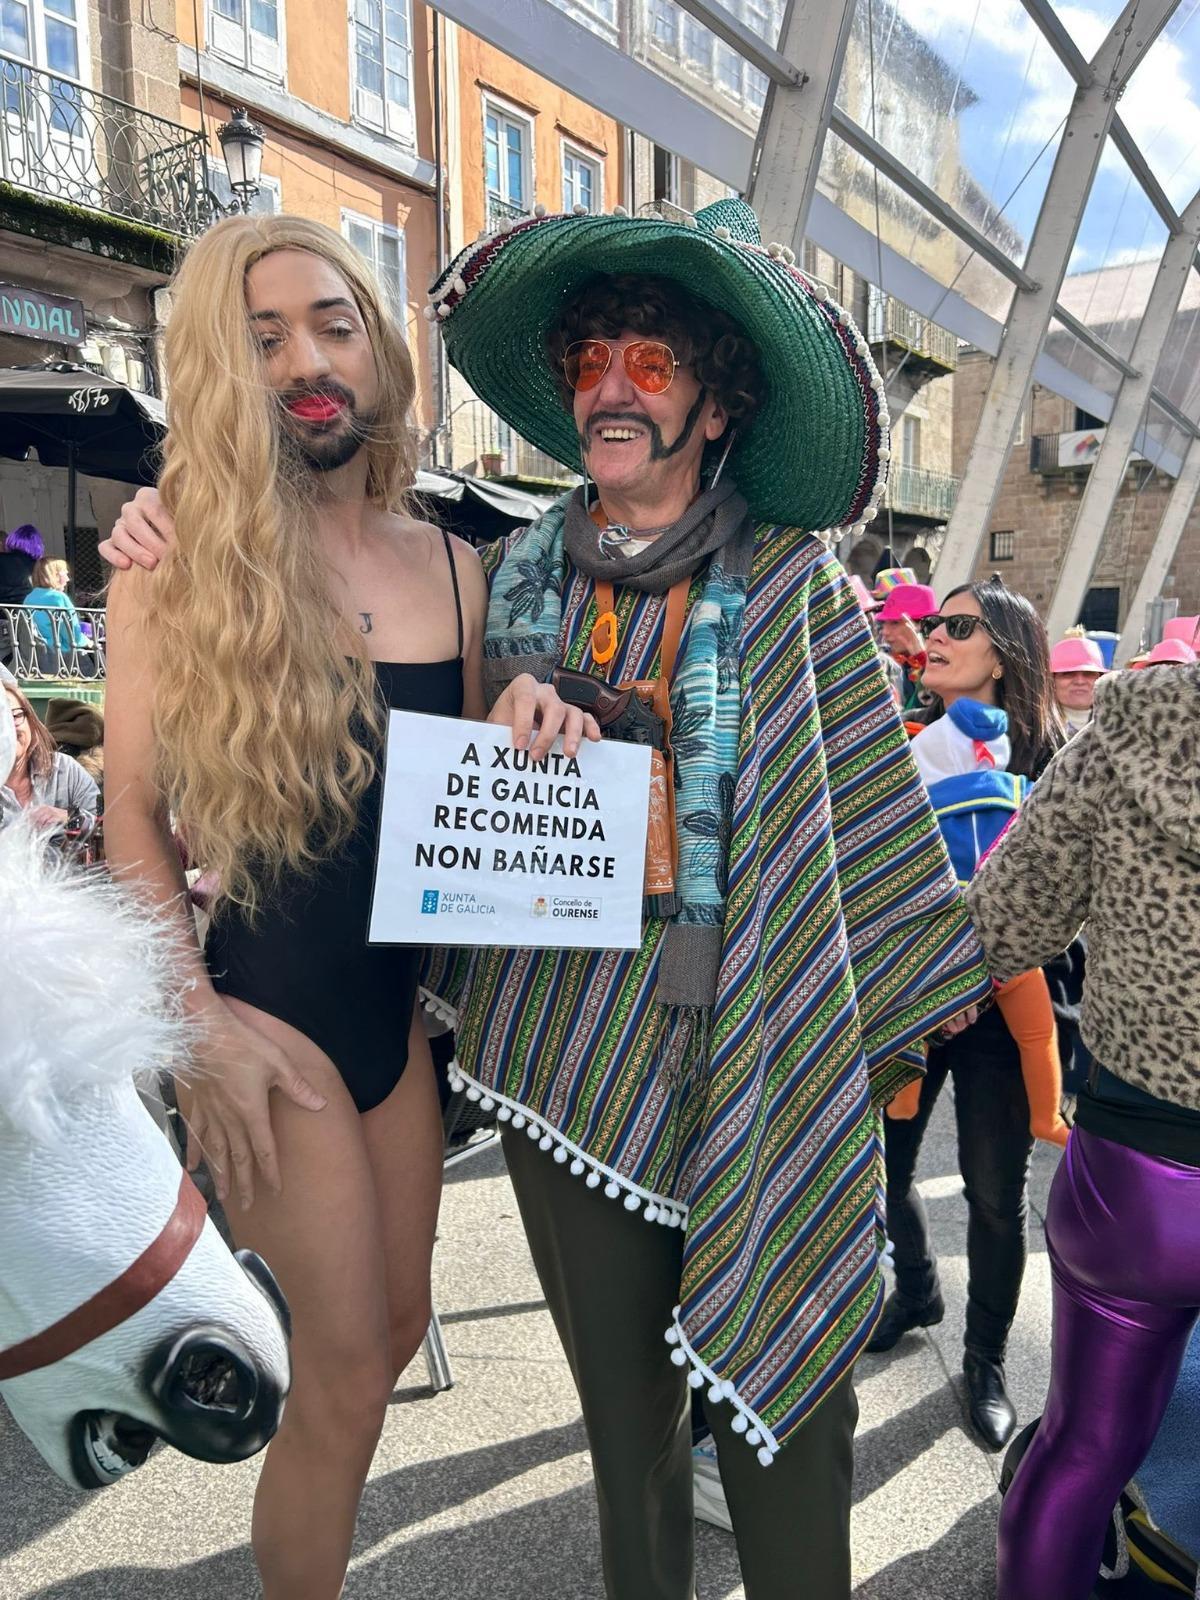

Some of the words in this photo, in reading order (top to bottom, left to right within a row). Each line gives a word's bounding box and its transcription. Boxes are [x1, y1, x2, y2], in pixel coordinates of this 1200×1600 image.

[1, 295, 80, 338] NDIAL
[461, 742, 480, 766] A
[490, 745, 581, 778] XUNTA
[447, 773, 480, 799] DE
[491, 778, 600, 811] GALICIA
[434, 805, 605, 841] RECOMENDA
[415, 843, 481, 870] NON
[492, 845, 615, 878] BAÑARSE
[440, 903, 453, 913] DE
[457, 904, 496, 915] GALICIA
[442, 892, 476, 903] XUNTA
[552, 908, 599, 919] OURENSE
[553, 898, 583, 907] Concello
[584, 899, 593, 908] de
